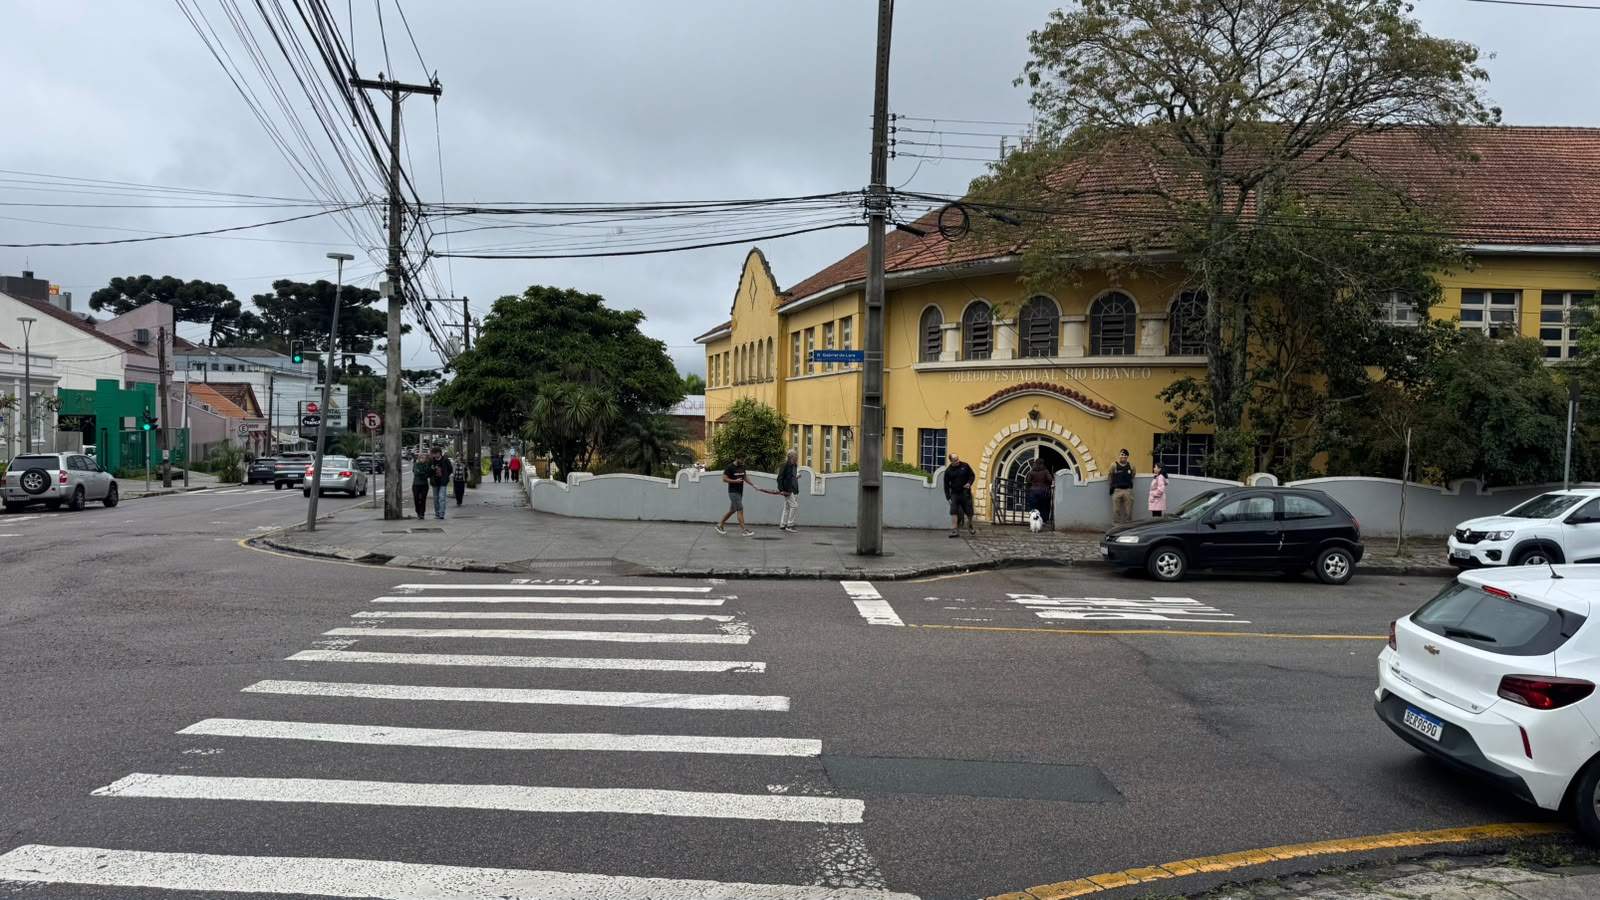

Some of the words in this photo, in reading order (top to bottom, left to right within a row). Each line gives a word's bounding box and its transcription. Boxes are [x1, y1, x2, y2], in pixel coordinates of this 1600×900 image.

[994, 369, 1058, 382] ESTADUAL
[1065, 367, 1087, 380] RIO
[1092, 367, 1151, 380] BRANCO
